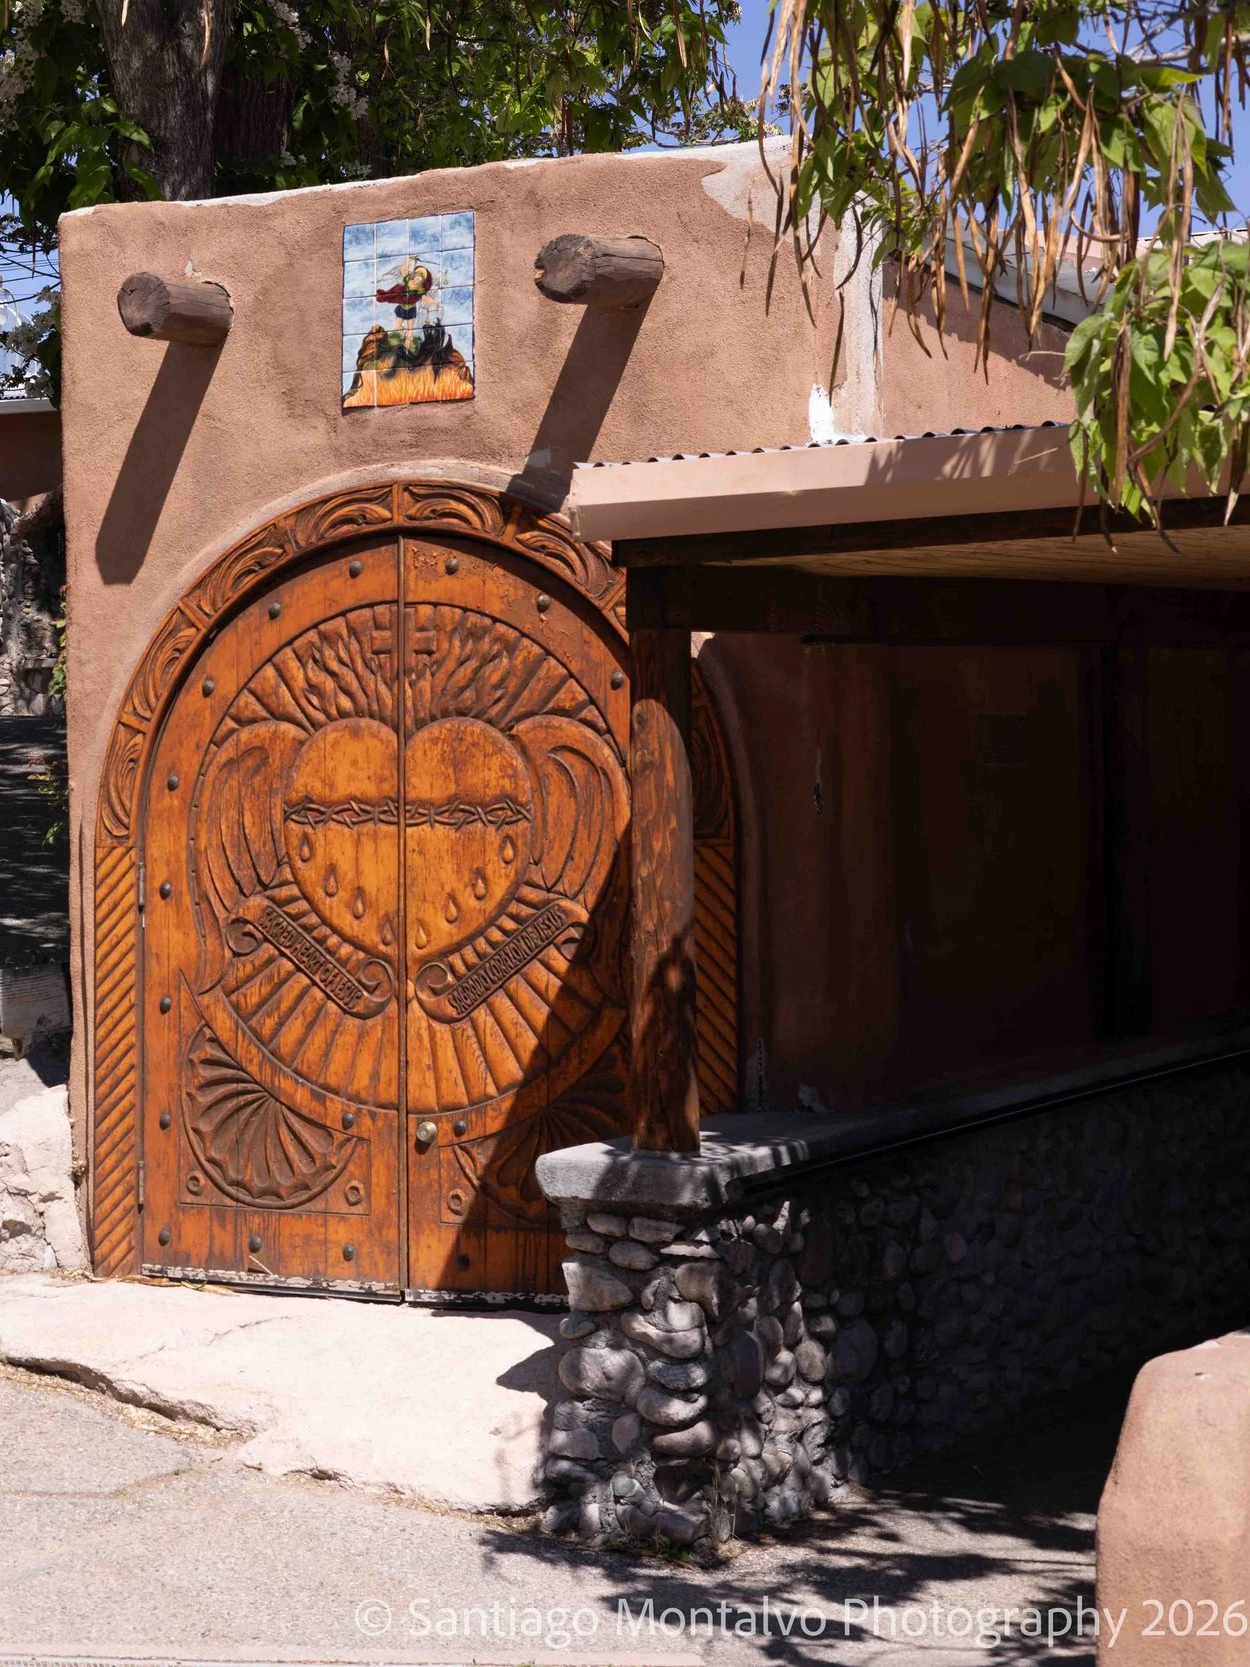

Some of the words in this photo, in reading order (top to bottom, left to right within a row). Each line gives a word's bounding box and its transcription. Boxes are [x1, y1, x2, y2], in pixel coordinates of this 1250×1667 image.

[256, 907, 299, 950] SACRED
[289, 936, 326, 975] HEART
[317, 961, 340, 987] OF
[329, 976, 363, 1009] JESUS
[446, 970, 492, 1015] SAGRADO
[483, 936, 532, 984] CORAZON
[520, 925, 544, 951] DE
[532, 905, 568, 942] JESUS
